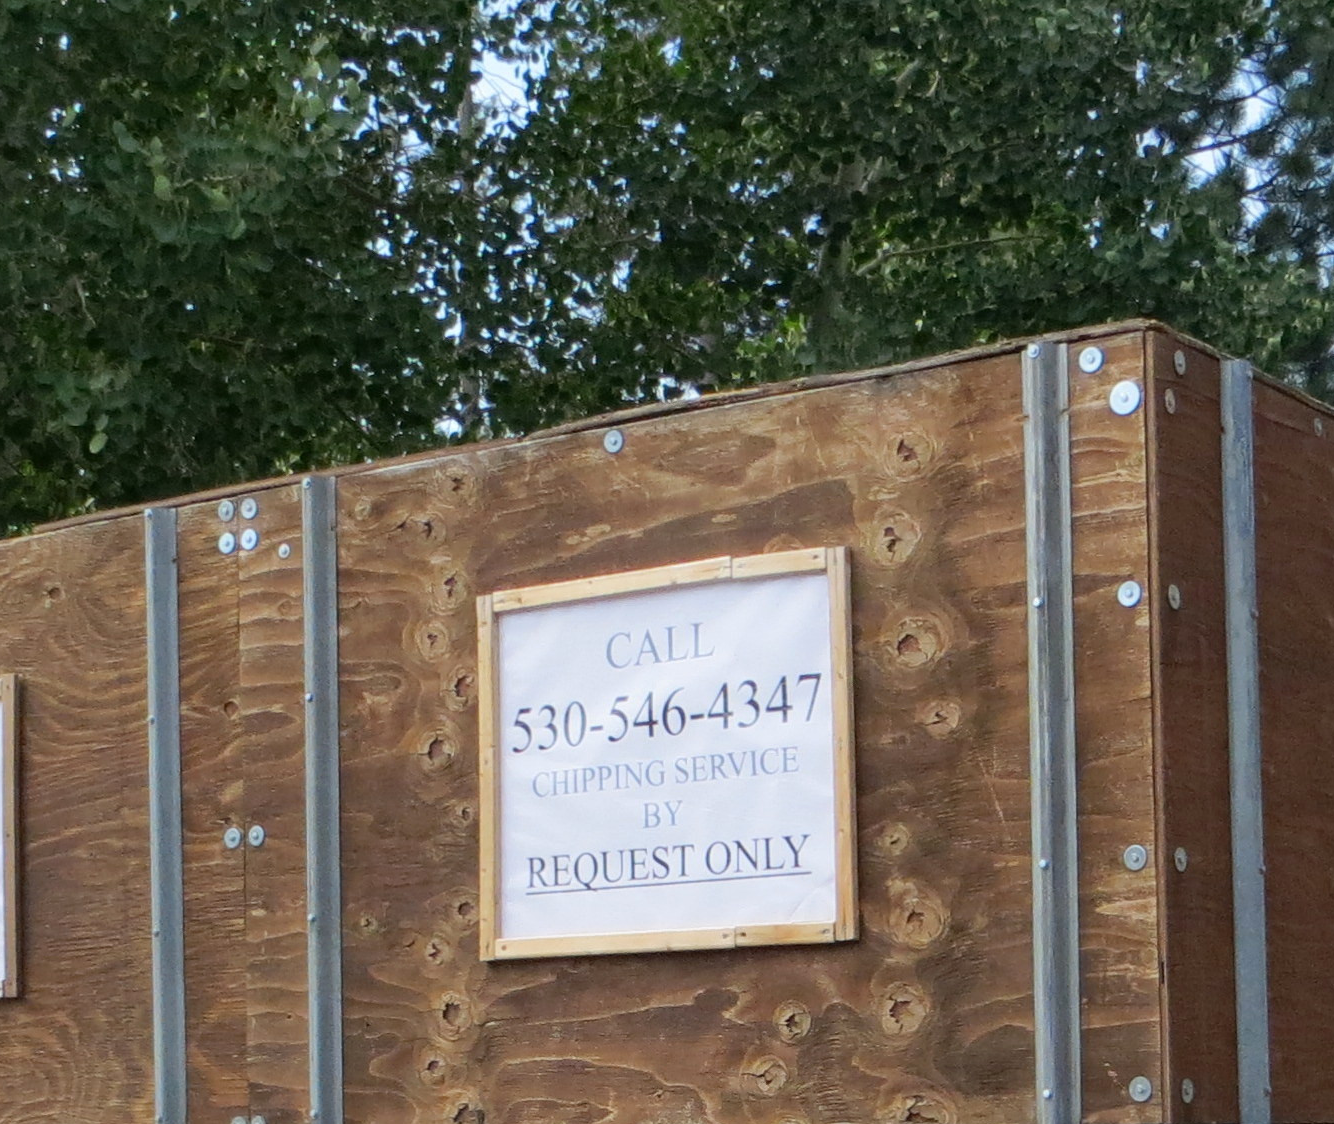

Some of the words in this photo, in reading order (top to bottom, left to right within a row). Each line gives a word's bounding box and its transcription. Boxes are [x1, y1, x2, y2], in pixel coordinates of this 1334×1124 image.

[605, 623, 715, 668] CALL
[512, 673, 822, 754] 530-546-4347
[532, 760, 666, 798] CHIPPING
[675, 747, 800, 784] SERVICE
[642, 800, 683, 829] BY
[525, 844, 695, 892] REQUEST
[705, 834, 810, 875] ONLY
